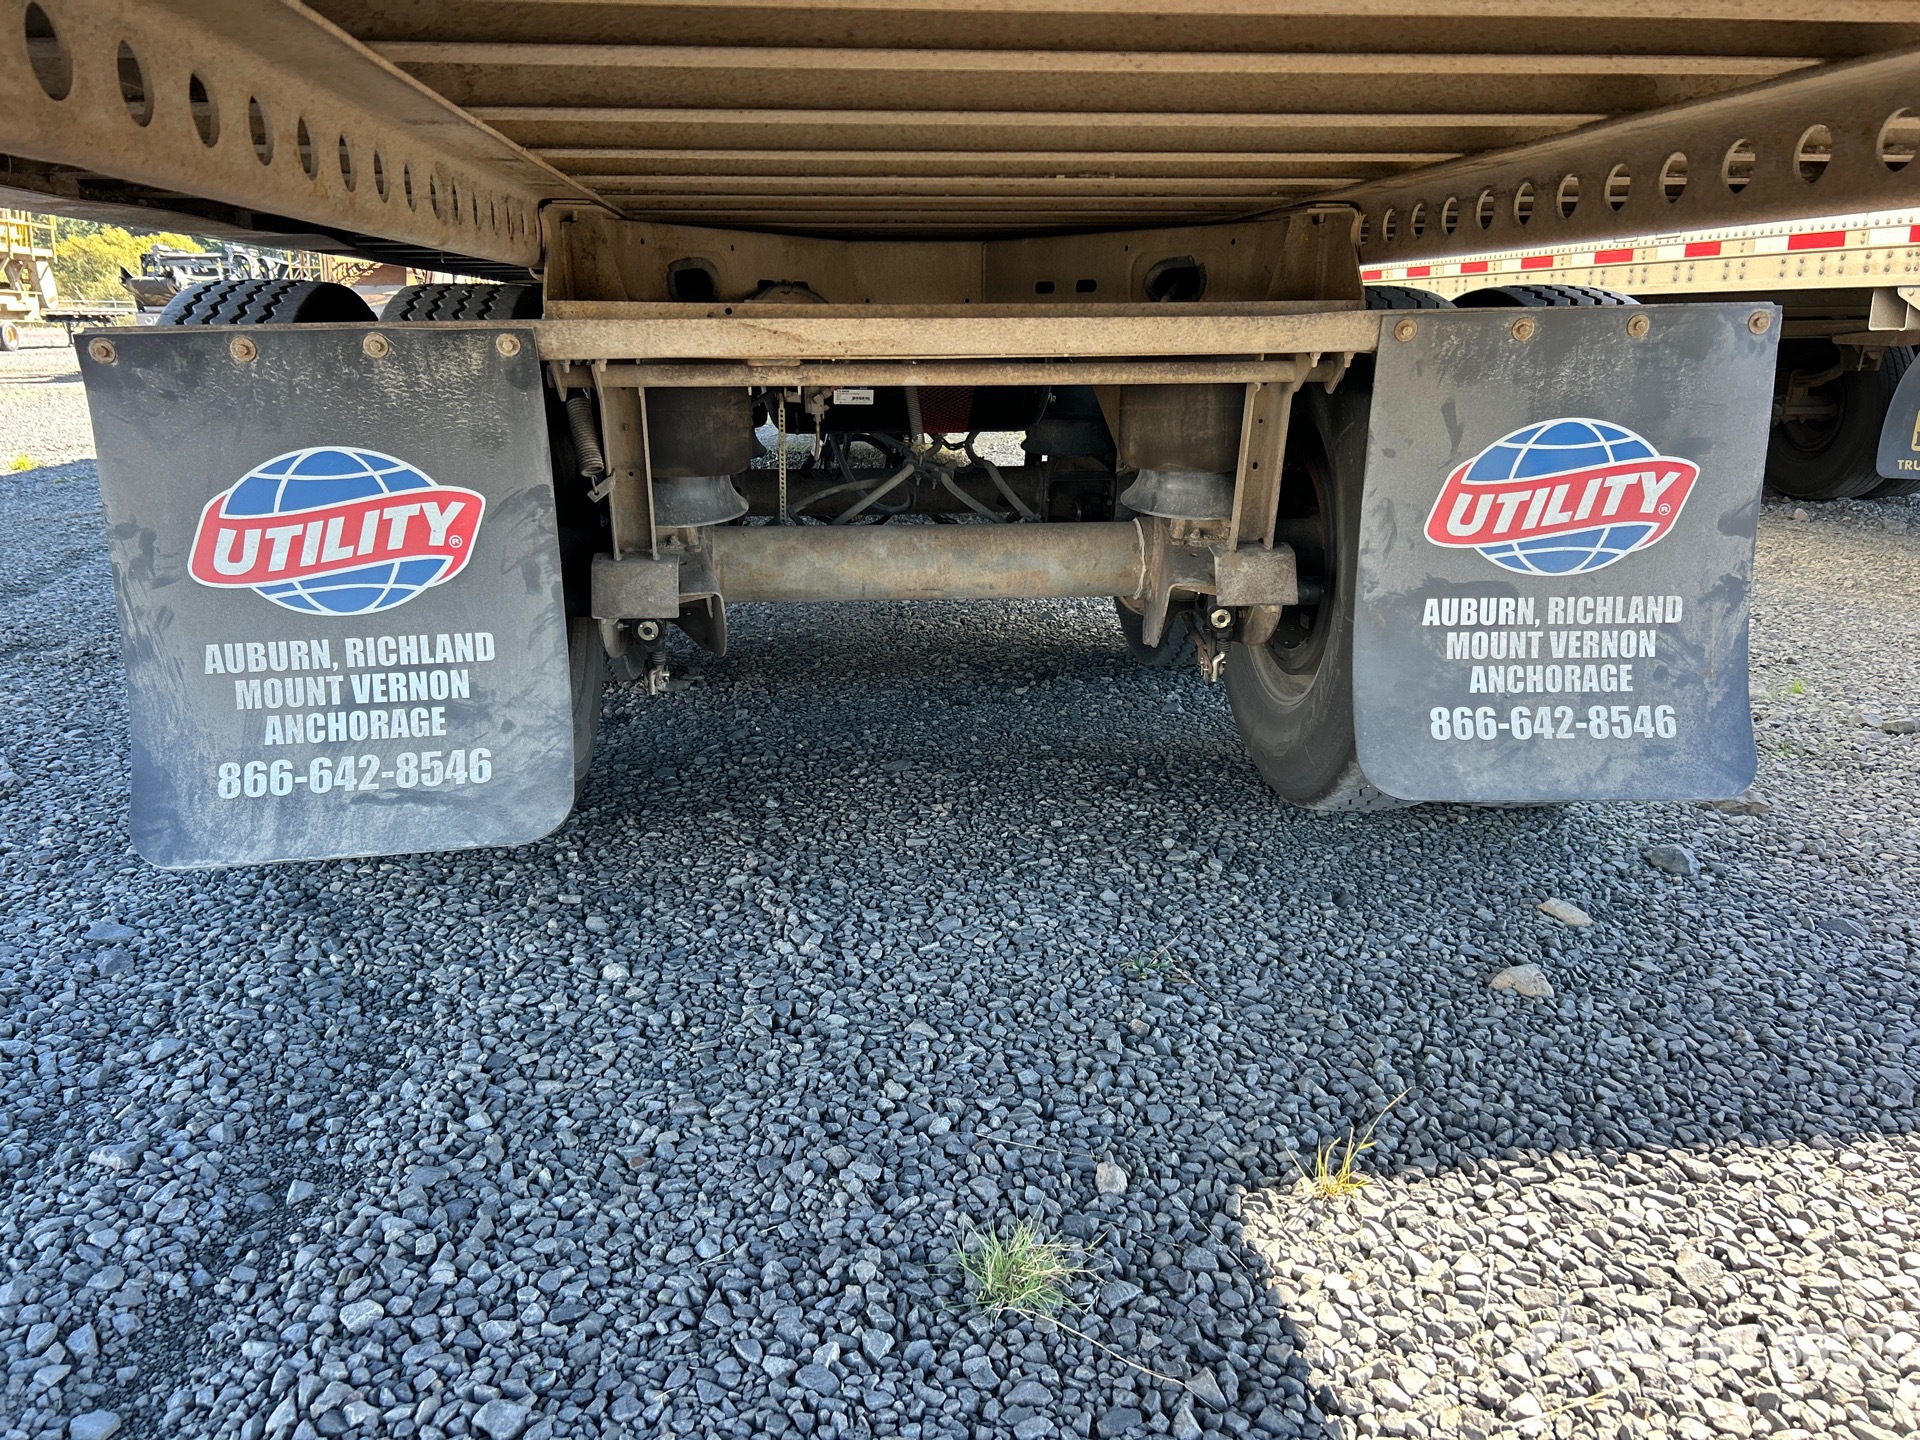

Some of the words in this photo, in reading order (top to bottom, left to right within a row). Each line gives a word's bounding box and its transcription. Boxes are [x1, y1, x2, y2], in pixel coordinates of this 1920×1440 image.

[1446, 471, 1681, 537] UTILITY
[213, 502, 466, 576] UTILITY
[1422, 597, 1540, 628] AUBURN,
[1548, 595, 1683, 625] RICHLAND
[205, 638, 338, 675] AUBURN,
[346, 632, 495, 668] RICHLAND
[1446, 630, 1543, 660] MOUNT
[1550, 629, 1656, 659] VERNON
[235, 676, 343, 710] MOUNT
[351, 669, 470, 705] VERNON
[1469, 664, 1633, 693] ANCHORAGE
[264, 706, 447, 746] ANCHORAGE
[1430, 704, 1677, 740] 866-642-8546
[217, 748, 492, 800] 866-642-8546
